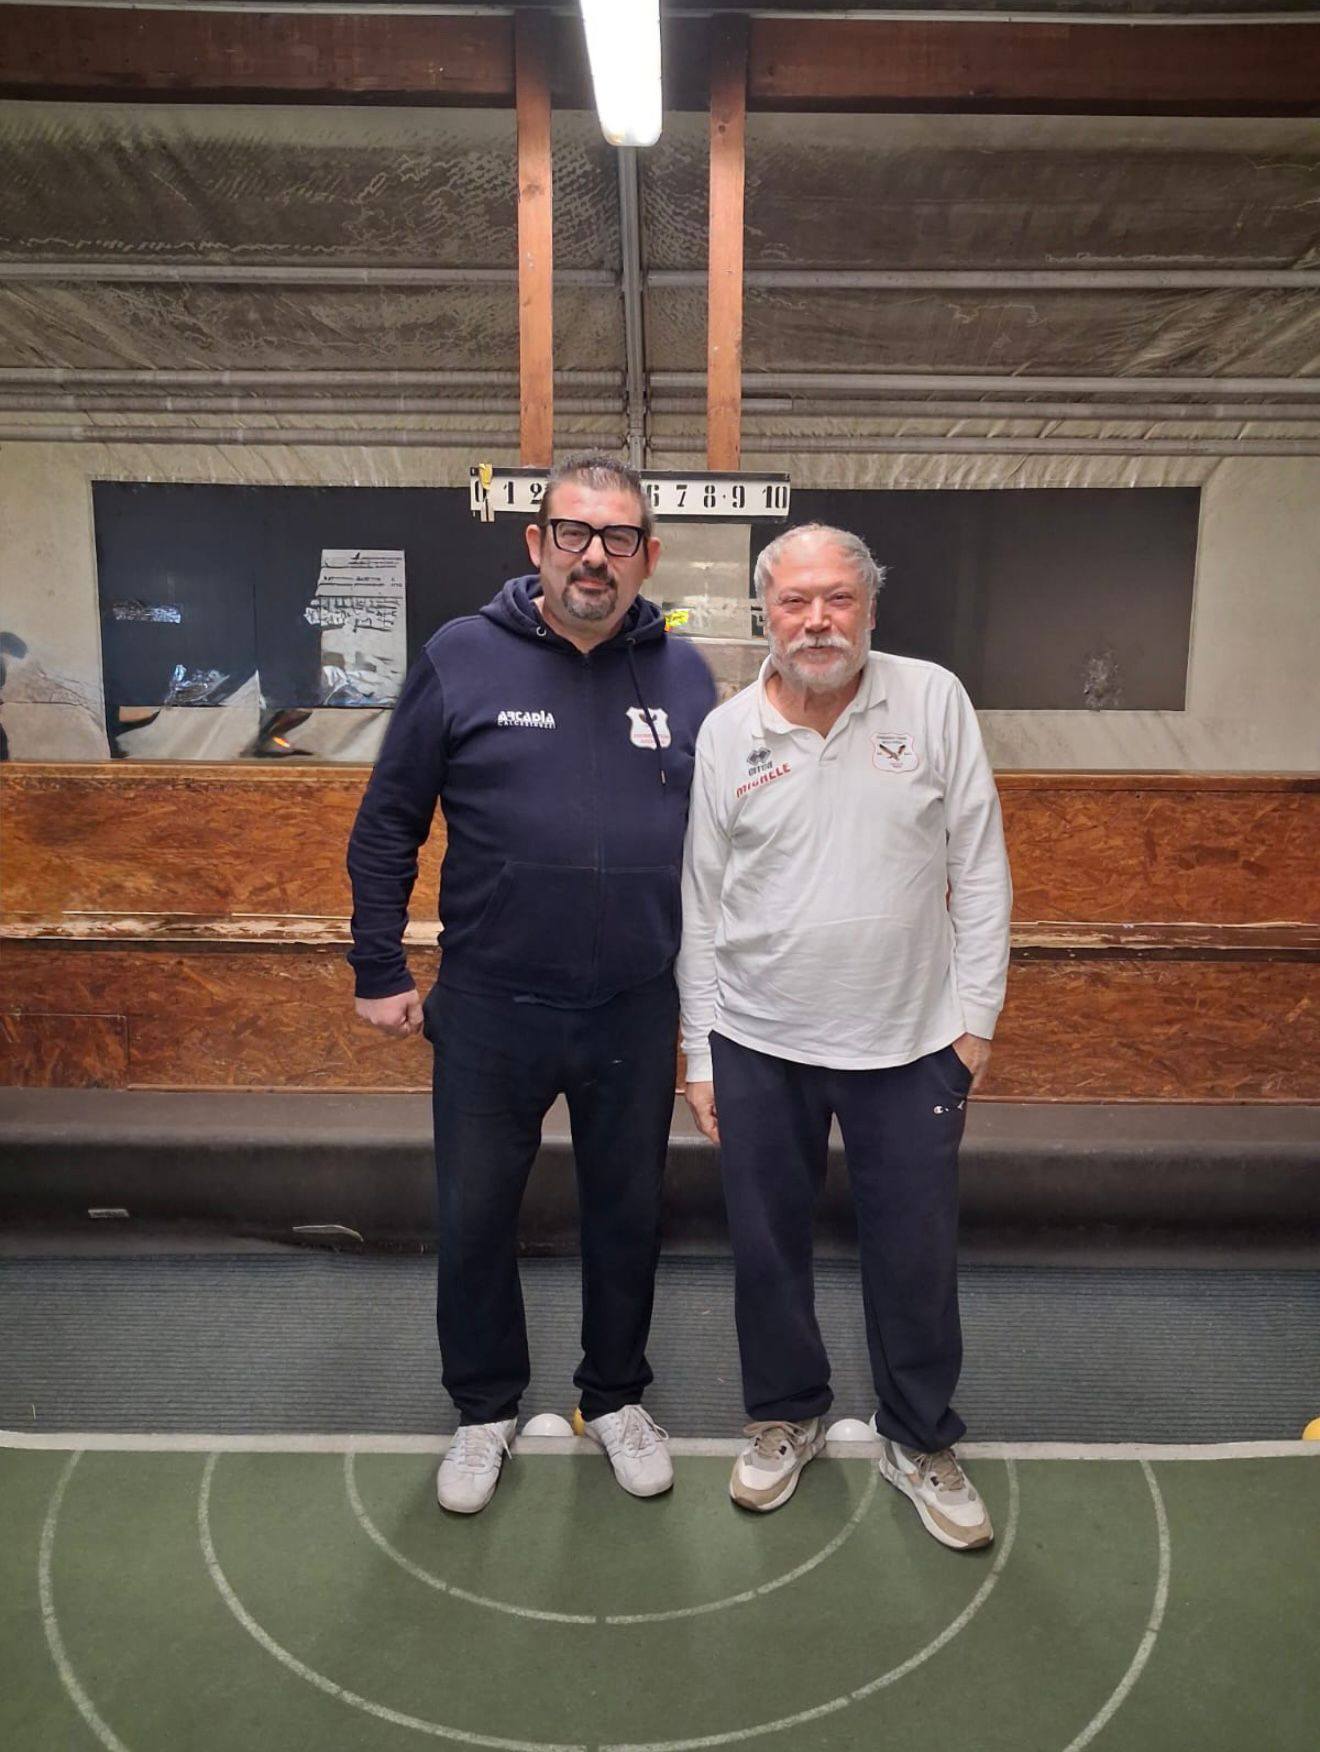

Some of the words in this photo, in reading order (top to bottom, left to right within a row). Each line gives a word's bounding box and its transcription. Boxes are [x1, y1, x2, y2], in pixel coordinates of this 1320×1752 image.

[503, 481, 515, 504] 1
[530, 482, 543, 505] 2
[675, 484, 688, 508] 7
[703, 485, 716, 508] 8
[732, 485, 745, 508] 9
[762, 485, 788, 509] 10
